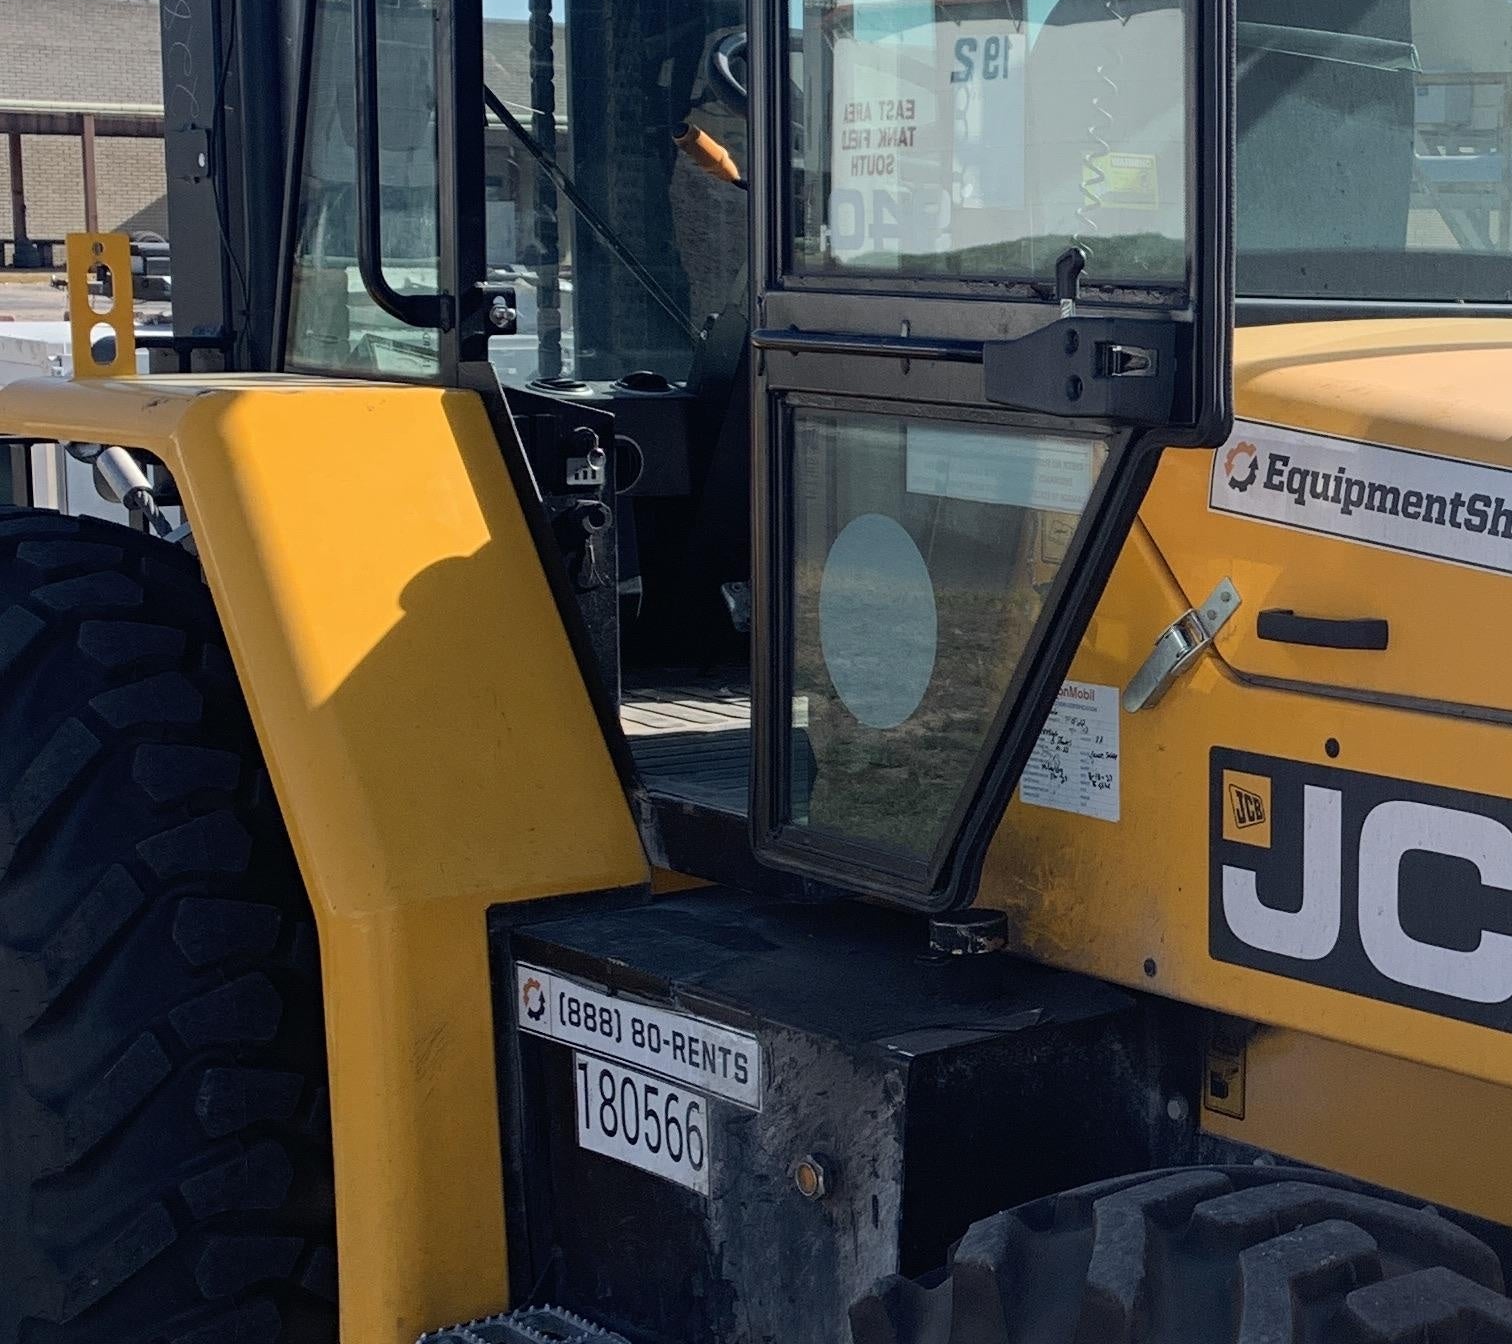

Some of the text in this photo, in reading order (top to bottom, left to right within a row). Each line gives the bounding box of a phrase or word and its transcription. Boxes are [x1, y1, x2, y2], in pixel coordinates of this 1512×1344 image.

[1233, 788, 1265, 824] JCB
[558, 991, 750, 1086] (888) 80-RENTS
[578, 1061, 705, 1172] 180566
